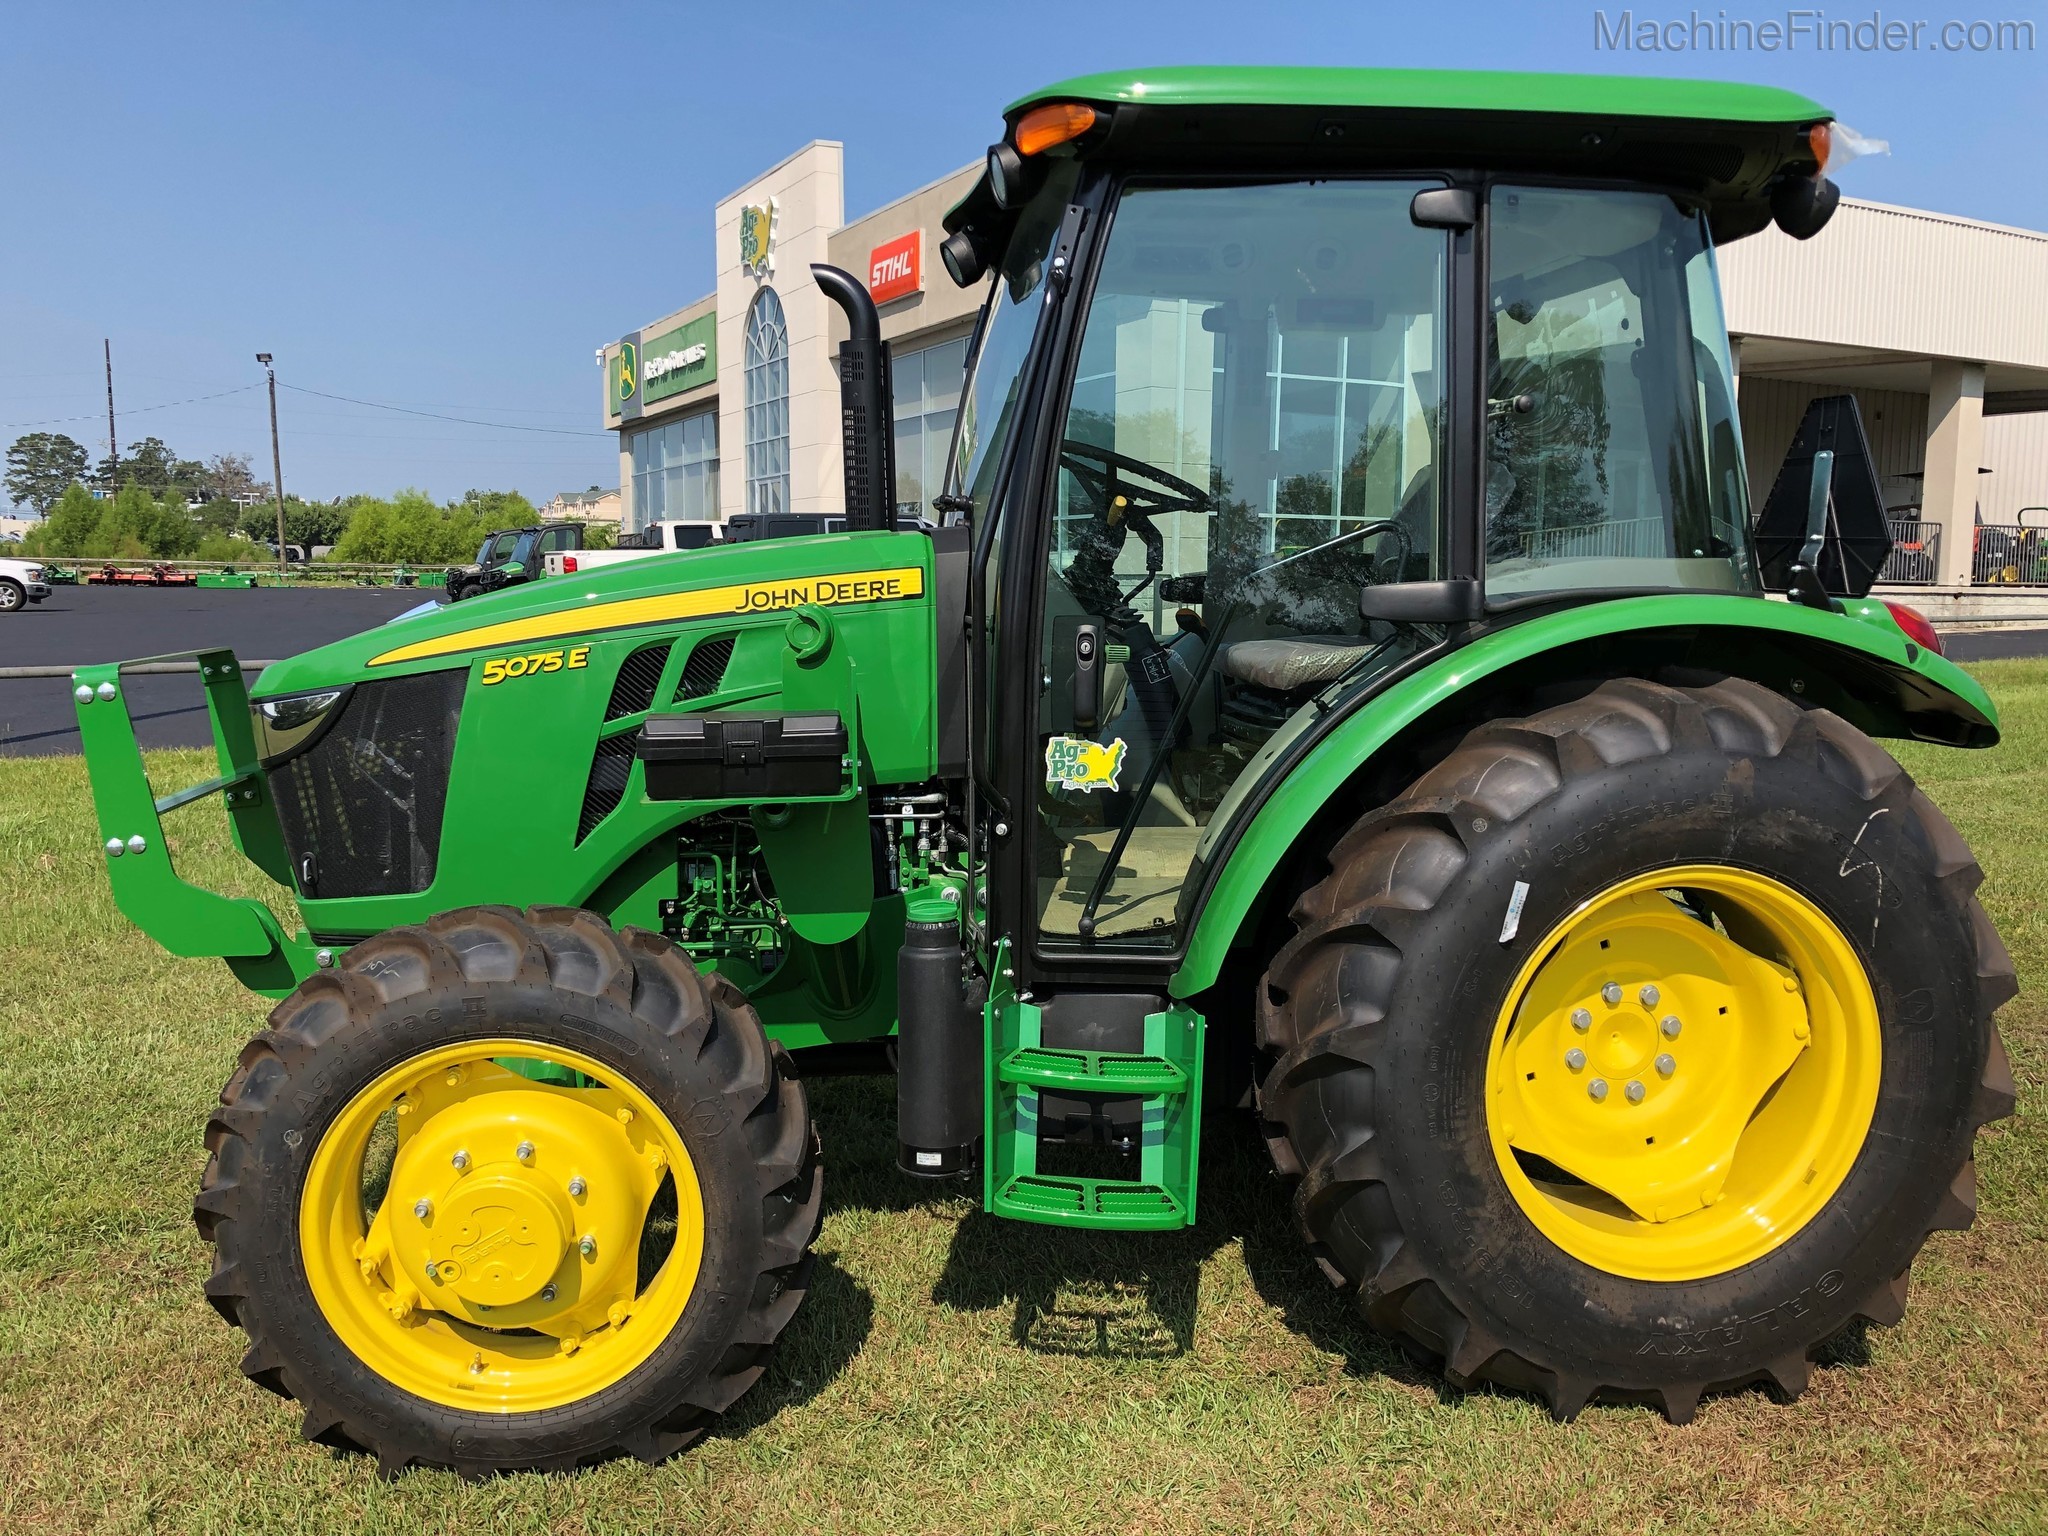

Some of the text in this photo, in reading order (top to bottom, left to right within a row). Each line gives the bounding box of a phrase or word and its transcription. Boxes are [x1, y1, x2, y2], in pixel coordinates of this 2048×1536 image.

[871, 250, 912, 288] STIHL
[735, 579, 901, 610] JOHN DEERE
[482, 650, 564, 685] 5075
[1050, 740, 1087, 762] Ag-
[1050, 760, 1088, 778] Pro
